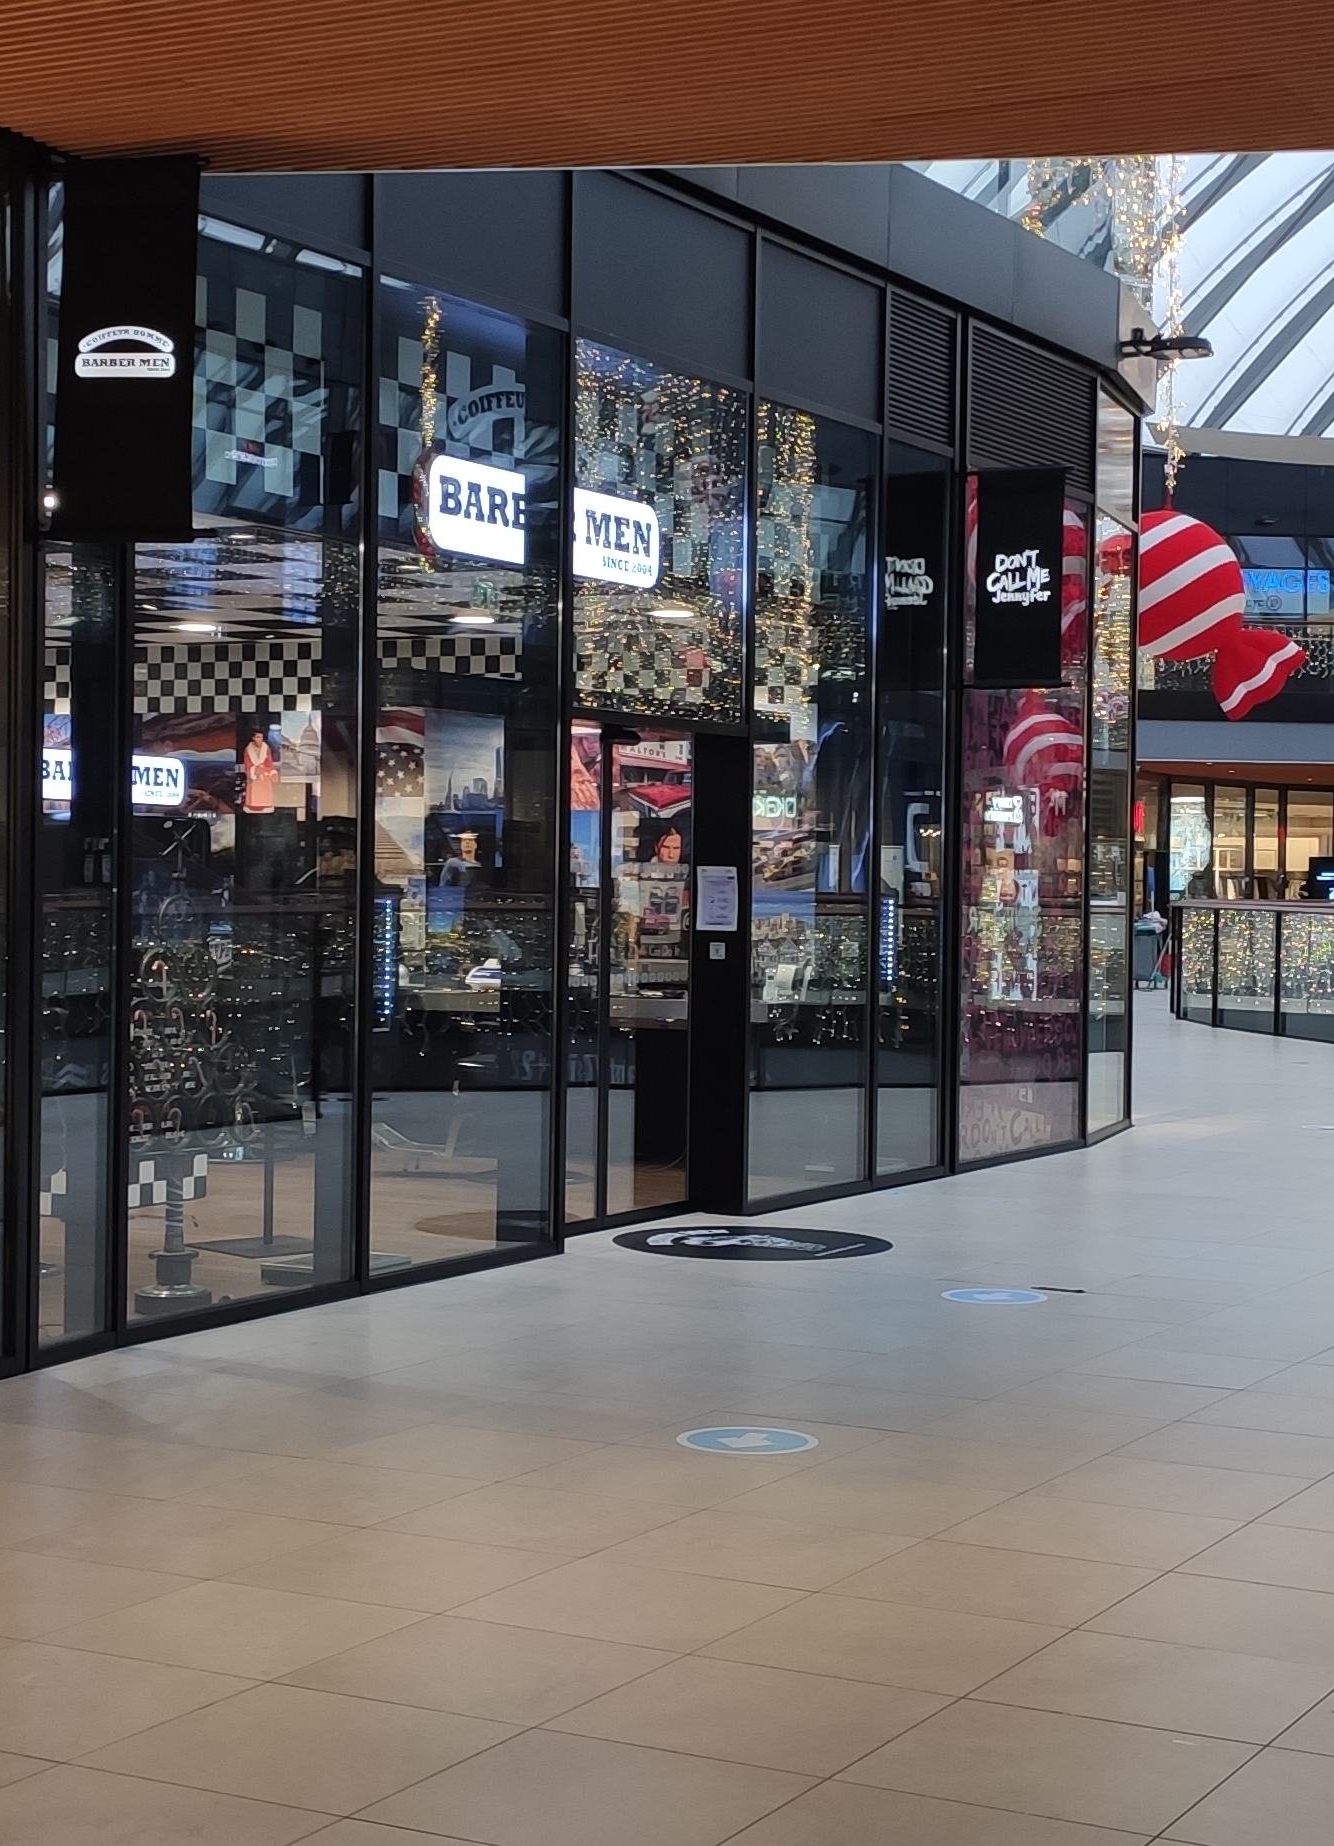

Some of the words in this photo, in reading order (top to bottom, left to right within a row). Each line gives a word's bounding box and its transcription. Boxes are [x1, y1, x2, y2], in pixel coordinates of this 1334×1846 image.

[82, 358, 136, 368] BARBER
[139, 358, 170, 368] MEN
[458, 390, 526, 425] COIFFEU
[585, 508, 652, 558] MEN
[602, 555, 629, 572] SINCE
[986, 572, 1026, 593] CALL
[1027, 566, 1050, 591] ME
[1245, 570, 1330, 593] YAGES
[992, 588, 1051, 606] Jennyfer
[131, 766, 179, 788] MEN
